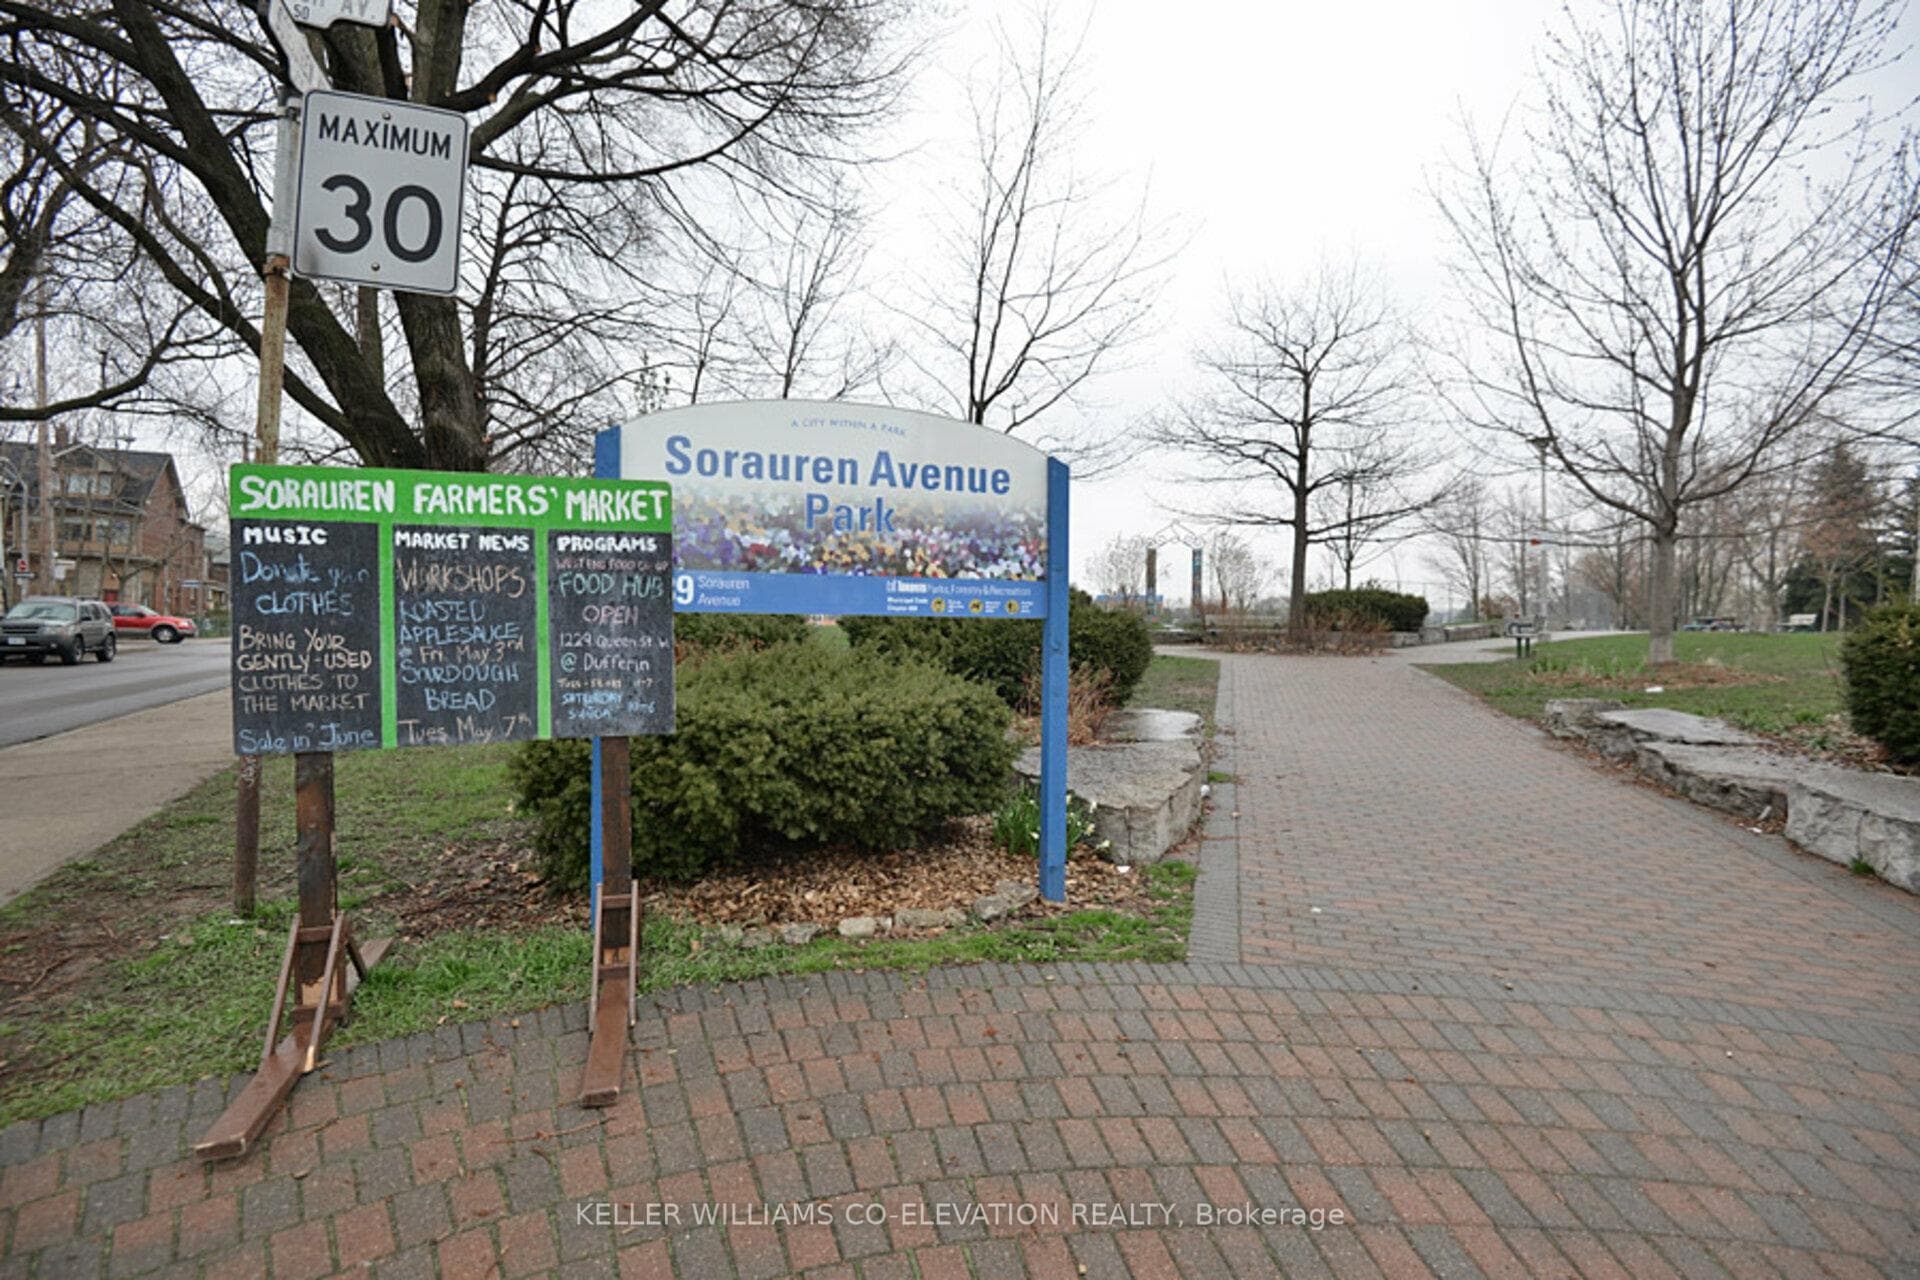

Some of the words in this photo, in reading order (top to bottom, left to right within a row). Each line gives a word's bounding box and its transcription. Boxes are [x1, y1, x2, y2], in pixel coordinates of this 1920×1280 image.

[318, 113, 451, 160] MAXIMUM
[314, 173, 443, 263] 30
[665, 435, 859, 487] Sorauren
[869, 450, 1010, 495] Avenue
[239, 475, 396, 513] SORAUREN
[413, 483, 559, 517] FARMERS'
[565, 488, 669, 523] MARKET
[805, 494, 896, 534] Park
[395, 530, 471, 551] MARKET
[479, 534, 530, 552] NEWS
[556, 534, 658, 553] PROGRAMS
[559, 571, 615, 599] FOOD
[622, 574, 663, 599] HUB
[698, 576, 750, 590] Sorauren
[255, 590, 353, 616] CLOTHES
[582, 604, 639, 625] OPEN
[239, 625, 296, 651] BRING
[238, 673, 324, 692] CLOTHES
[333, 673, 359, 690] TO
[239, 694, 279, 714] THE
[290, 693, 371, 712] MARKET
[424, 688, 497, 714] BREAD
[238, 728, 287, 754] Sale
[319, 722, 379, 750] June
[455, 715, 495, 744] May
